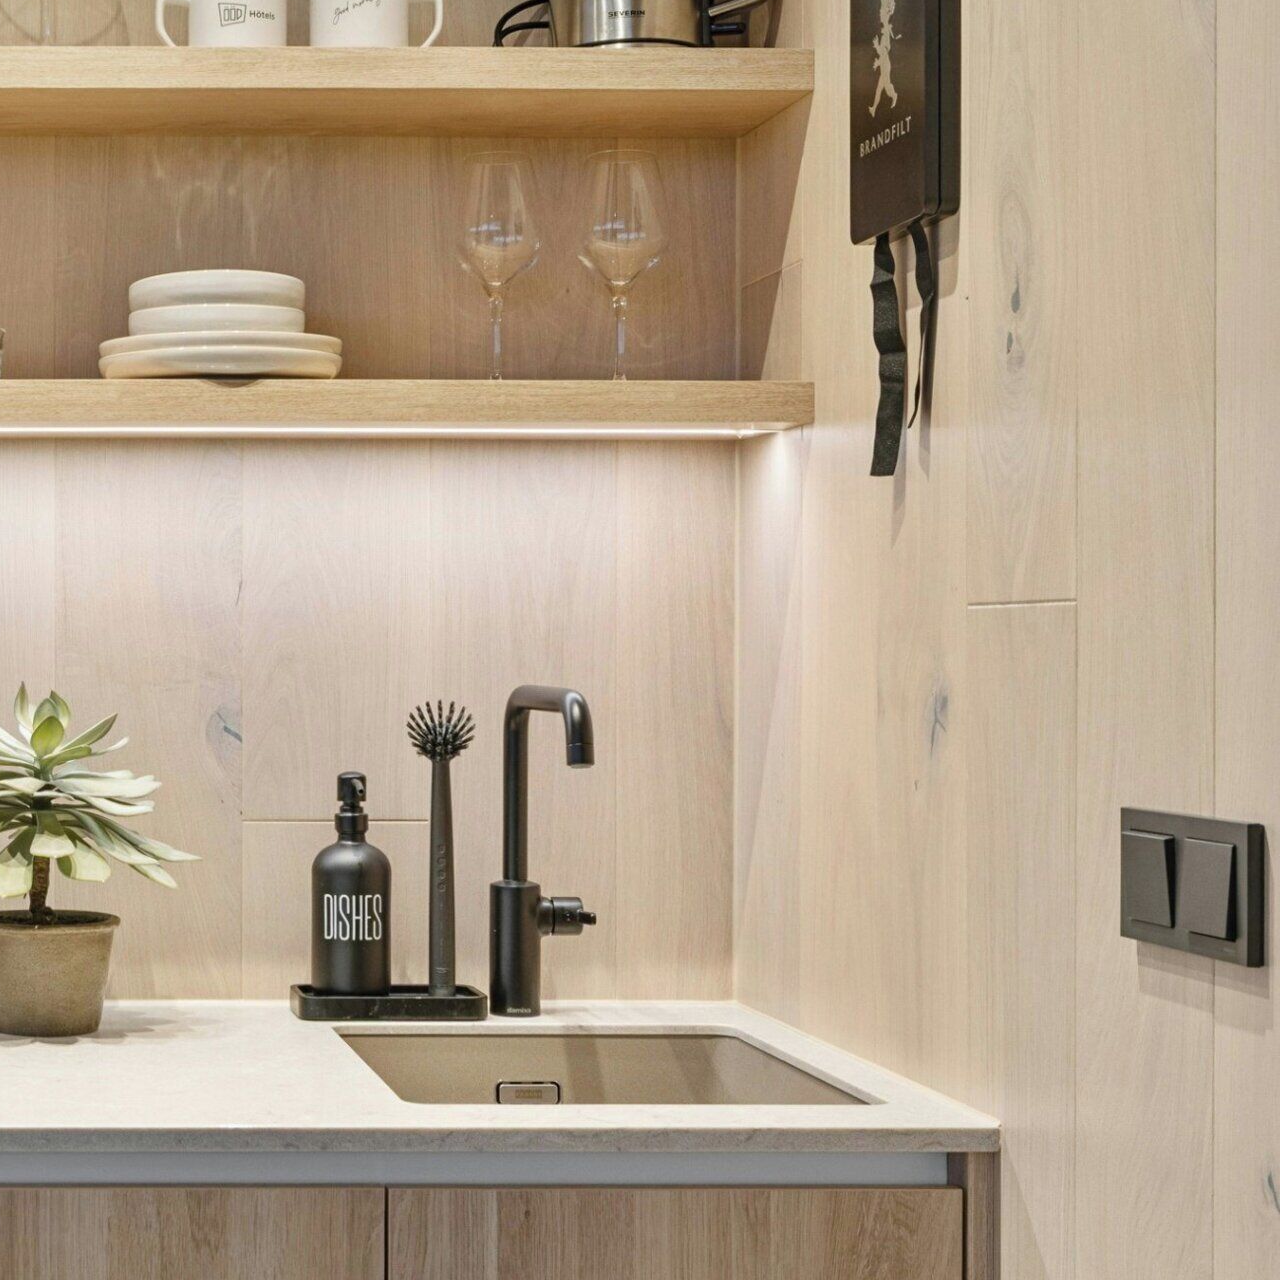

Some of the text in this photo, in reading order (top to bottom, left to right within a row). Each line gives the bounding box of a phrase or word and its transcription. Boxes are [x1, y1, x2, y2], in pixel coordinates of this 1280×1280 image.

[607, 9, 646, 18] SEVERIN
[860, 116, 911, 157] BRANDFILT
[323, 893, 383, 941] DISHES
